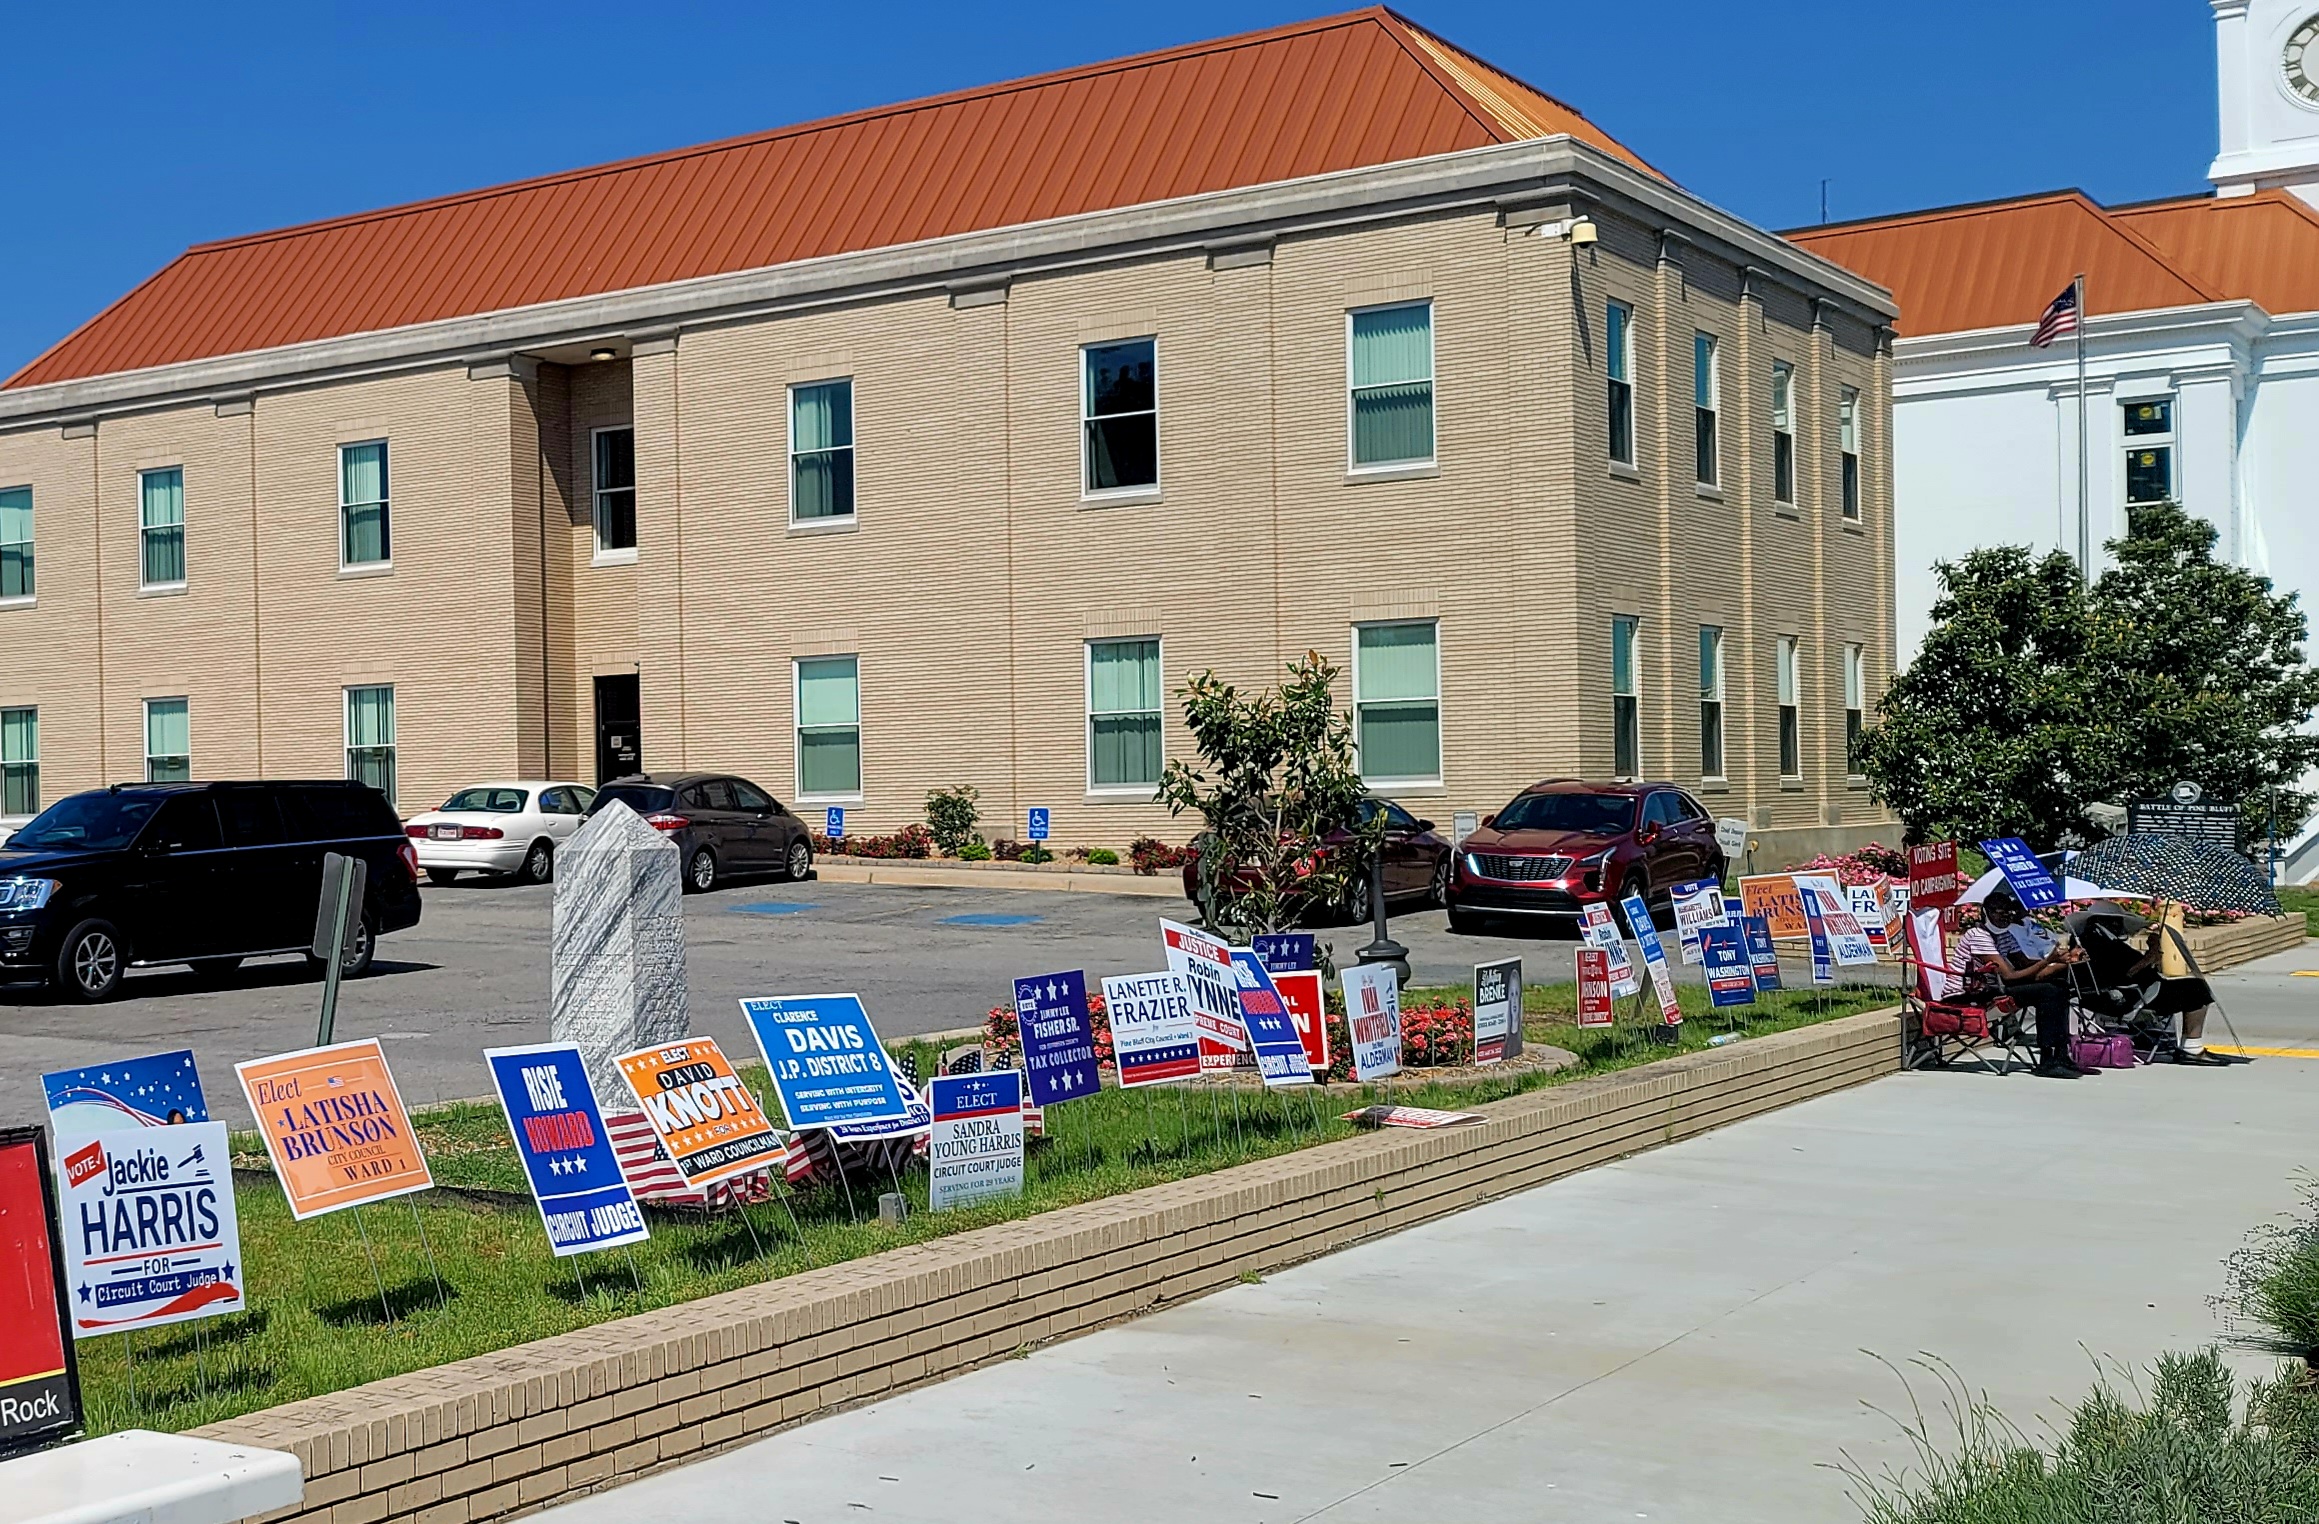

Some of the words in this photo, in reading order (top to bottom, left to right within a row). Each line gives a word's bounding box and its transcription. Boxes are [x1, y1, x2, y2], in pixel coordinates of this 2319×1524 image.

[2139, 803, 2171, 811] BATTLE
[2209, 805, 2234, 813] BLUFF
[1914, 845, 1936, 864] VOTING
[1937, 842, 1951, 859] SITE
[1746, 884, 1772, 896] Elect
[1911, 880, 1920, 898] NO
[1920, 873, 1956, 896] CAMPAIGNING
[1758, 893, 1801, 908] LATIS
[1680, 908, 1713, 926] WILLIAMS
[1178, 934, 1221, 962] JUSTICE
[1717, 949, 1736, 962] TONY
[1187, 956, 1222, 982] Robin
[1706, 965, 1751, 979] WASHINGTON
[1108, 978, 1170, 1000] LANETTE
[1172, 976, 1187, 994] R.
[750, 1000, 783, 1011] ELECT
[772, 1010, 819, 1024] CLARENCE
[1040, 1007, 1059, 1021] JIMMY
[1059, 1006, 1070, 1016] LEE
[1112, 995, 1191, 1026] FRAZIER
[1033, 1018, 1067, 1040] FISHER
[1066, 1016, 1081, 1033] SR.
[1194, 1014, 1217, 1031] PREME
[784, 1024, 865, 1053] DAVIS
[658, 1046, 692, 1065] ELECT
[777, 1059, 808, 1080] J.P.
[805, 1052, 869, 1077] DISTRICT
[868, 1051, 883, 1072] 8
[1029, 1054, 1049, 1071] TAX
[1049, 1045, 1093, 1066] COLLECTOR
[1361, 1046, 1395, 1071] ALDERMAN
[521, 1064, 568, 1112] RISIE
[659, 1063, 715, 1089] DAVID
[258, 1077, 302, 1105] Elect
[794, 1089, 826, 1100] SERVING
[825, 1087, 845, 1097] WITH
[956, 1092, 998, 1109] ELECT
[283, 1089, 390, 1132] LATISHA
[643, 1075, 752, 1136] KNOTT
[800, 1101, 833, 1113] SERVING
[832, 1100, 852, 1109] WITH
[853, 1096, 887, 1108] PURPOSE
[280, 1114, 397, 1161] BRUNSON
[523, 1110, 595, 1154] HOWARD
[713, 1124, 731, 1136] FOR
[953, 1118, 1001, 1140] SANDRA
[327, 1151, 349, 1165] CITY
[348, 1144, 386, 1160] COUNCIL
[679, 1159, 693, 1175] 1ST
[692, 1151, 726, 1169] WARD
[724, 1134, 780, 1159] COUNCILMAN
[934, 1138, 977, 1159] YOUNG
[978, 1132, 1021, 1153] HARRIS
[67, 1156, 96, 1181] VOTE
[102, 1147, 170, 1197] Jackie
[344, 1158, 393, 1181] WARD
[399, 1158, 406, 1170] 1
[933, 1163, 967, 1179] CIRCUIT
[967, 1159, 996, 1174] COURT
[995, 1155, 1022, 1174] JUDGE
[939, 1180, 970, 1194] SERVING
[970, 1179, 985, 1189] FOR
[994, 1175, 1016, 1186] YEARS
[80, 1187, 220, 1256] HARRIS
[546, 1211, 591, 1243] CIRCUIT
[590, 1200, 641, 1237] JUDGE
[143, 1257, 170, 1276] FOR
[97, 1282, 144, 1302] Circuit
[149, 1278, 181, 1294] Court
[186, 1272, 217, 1289] Judge
[0, 1388, 60, 1427] Rock
